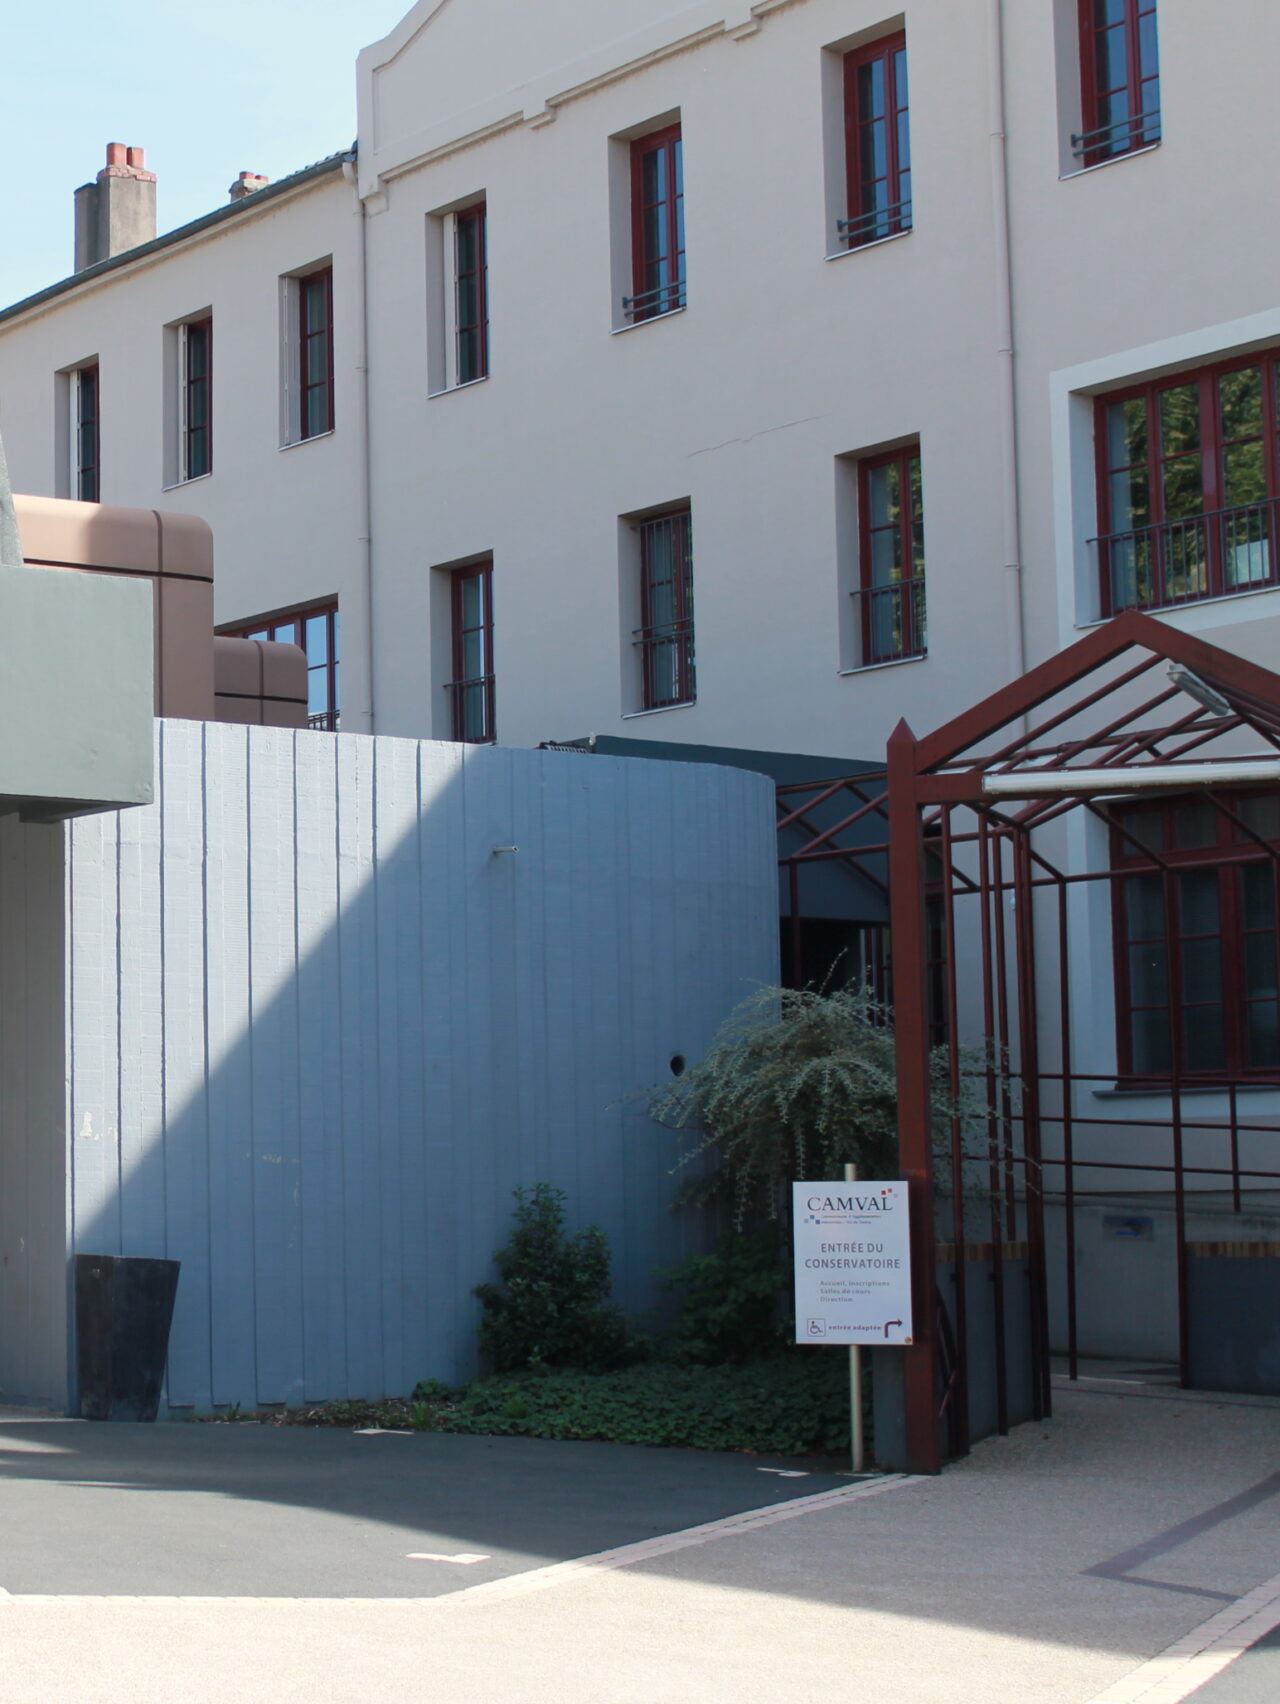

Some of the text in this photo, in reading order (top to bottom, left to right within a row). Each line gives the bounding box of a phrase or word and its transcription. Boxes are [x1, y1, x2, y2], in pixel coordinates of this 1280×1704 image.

[807, 1196, 893, 1211] CAMVAL
[821, 1240, 883, 1253] ENTRÉE DU
[805, 1258, 901, 1269] CONSERVATOIRE
